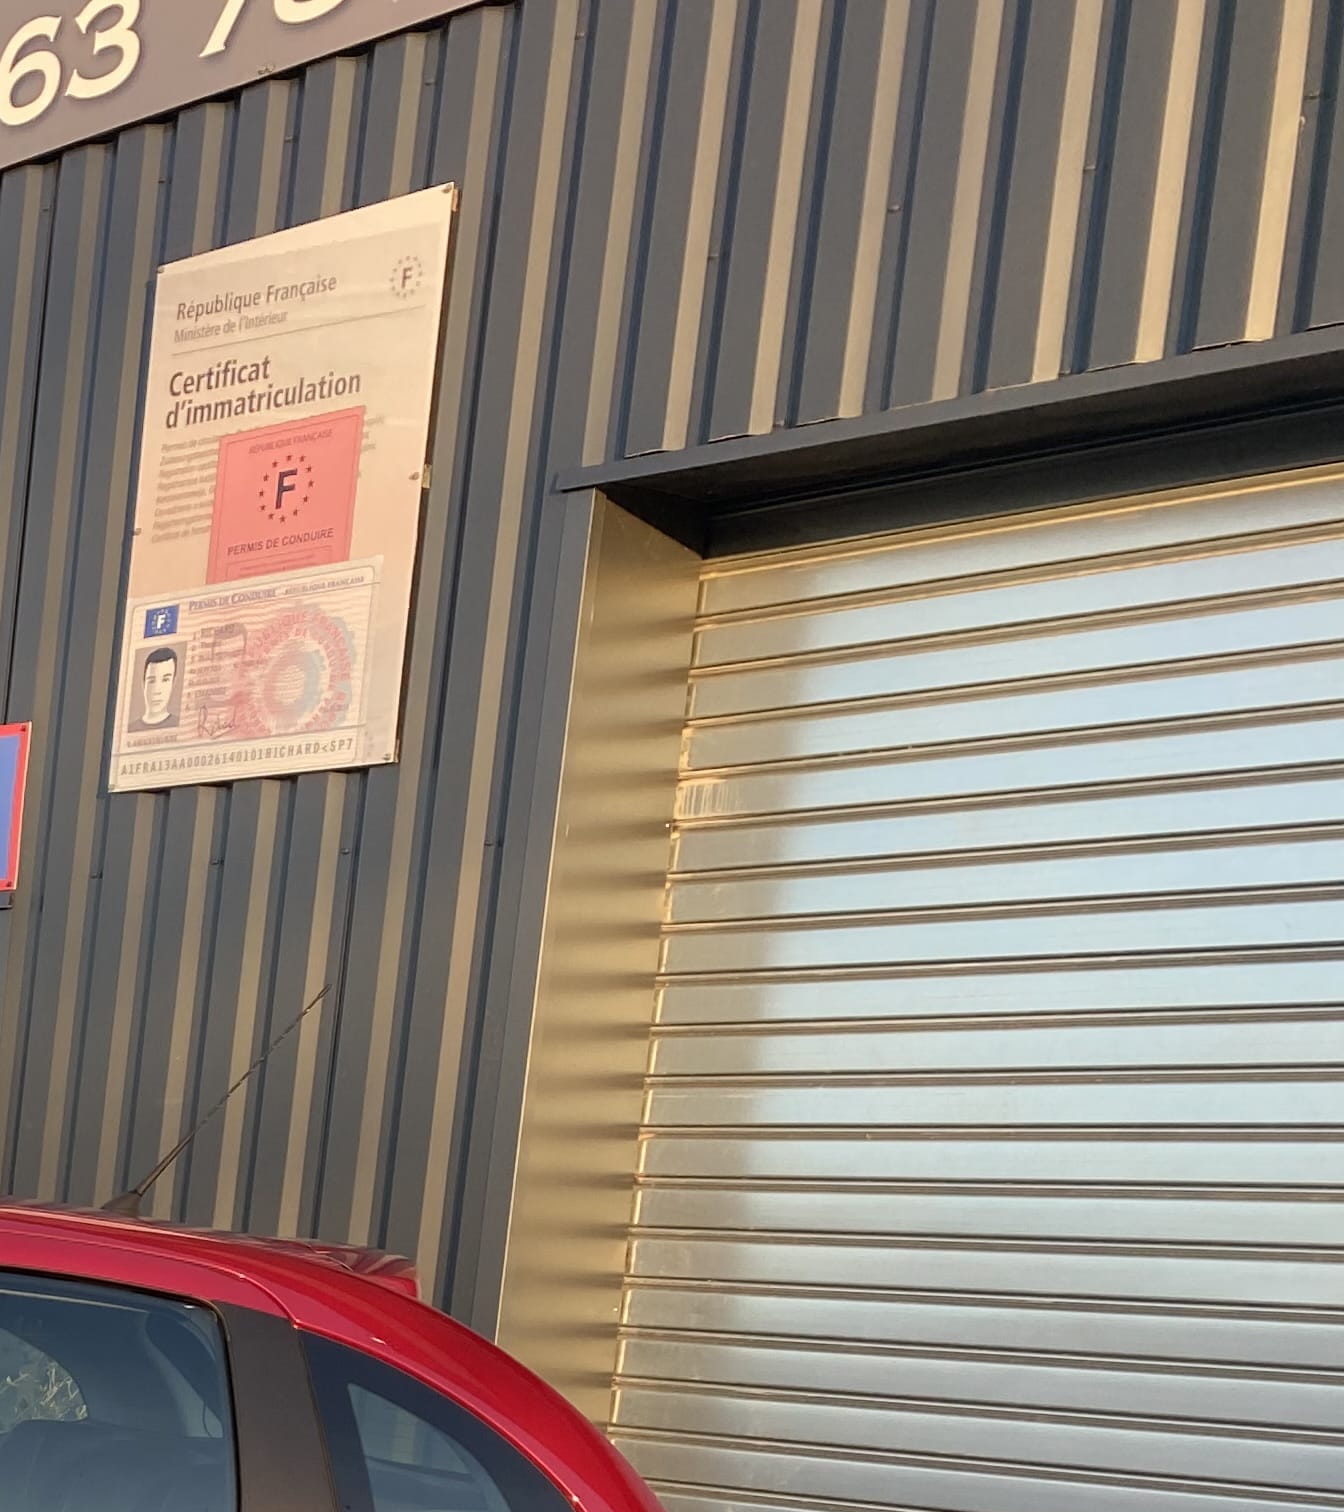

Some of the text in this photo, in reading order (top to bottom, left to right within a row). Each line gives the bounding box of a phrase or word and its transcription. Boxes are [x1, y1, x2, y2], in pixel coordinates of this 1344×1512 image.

[176, 291, 261, 322] République
[267, 273, 338, 301] Française
[174, 321, 221, 344] Ministère
[223, 319, 237, 334] de
[169, 355, 271, 397] Certificat
[165, 371, 362, 429] d'immatriculation
[275, 468, 298, 509] F
[226, 527, 335, 556] PERMIS DE CONDUIRE
